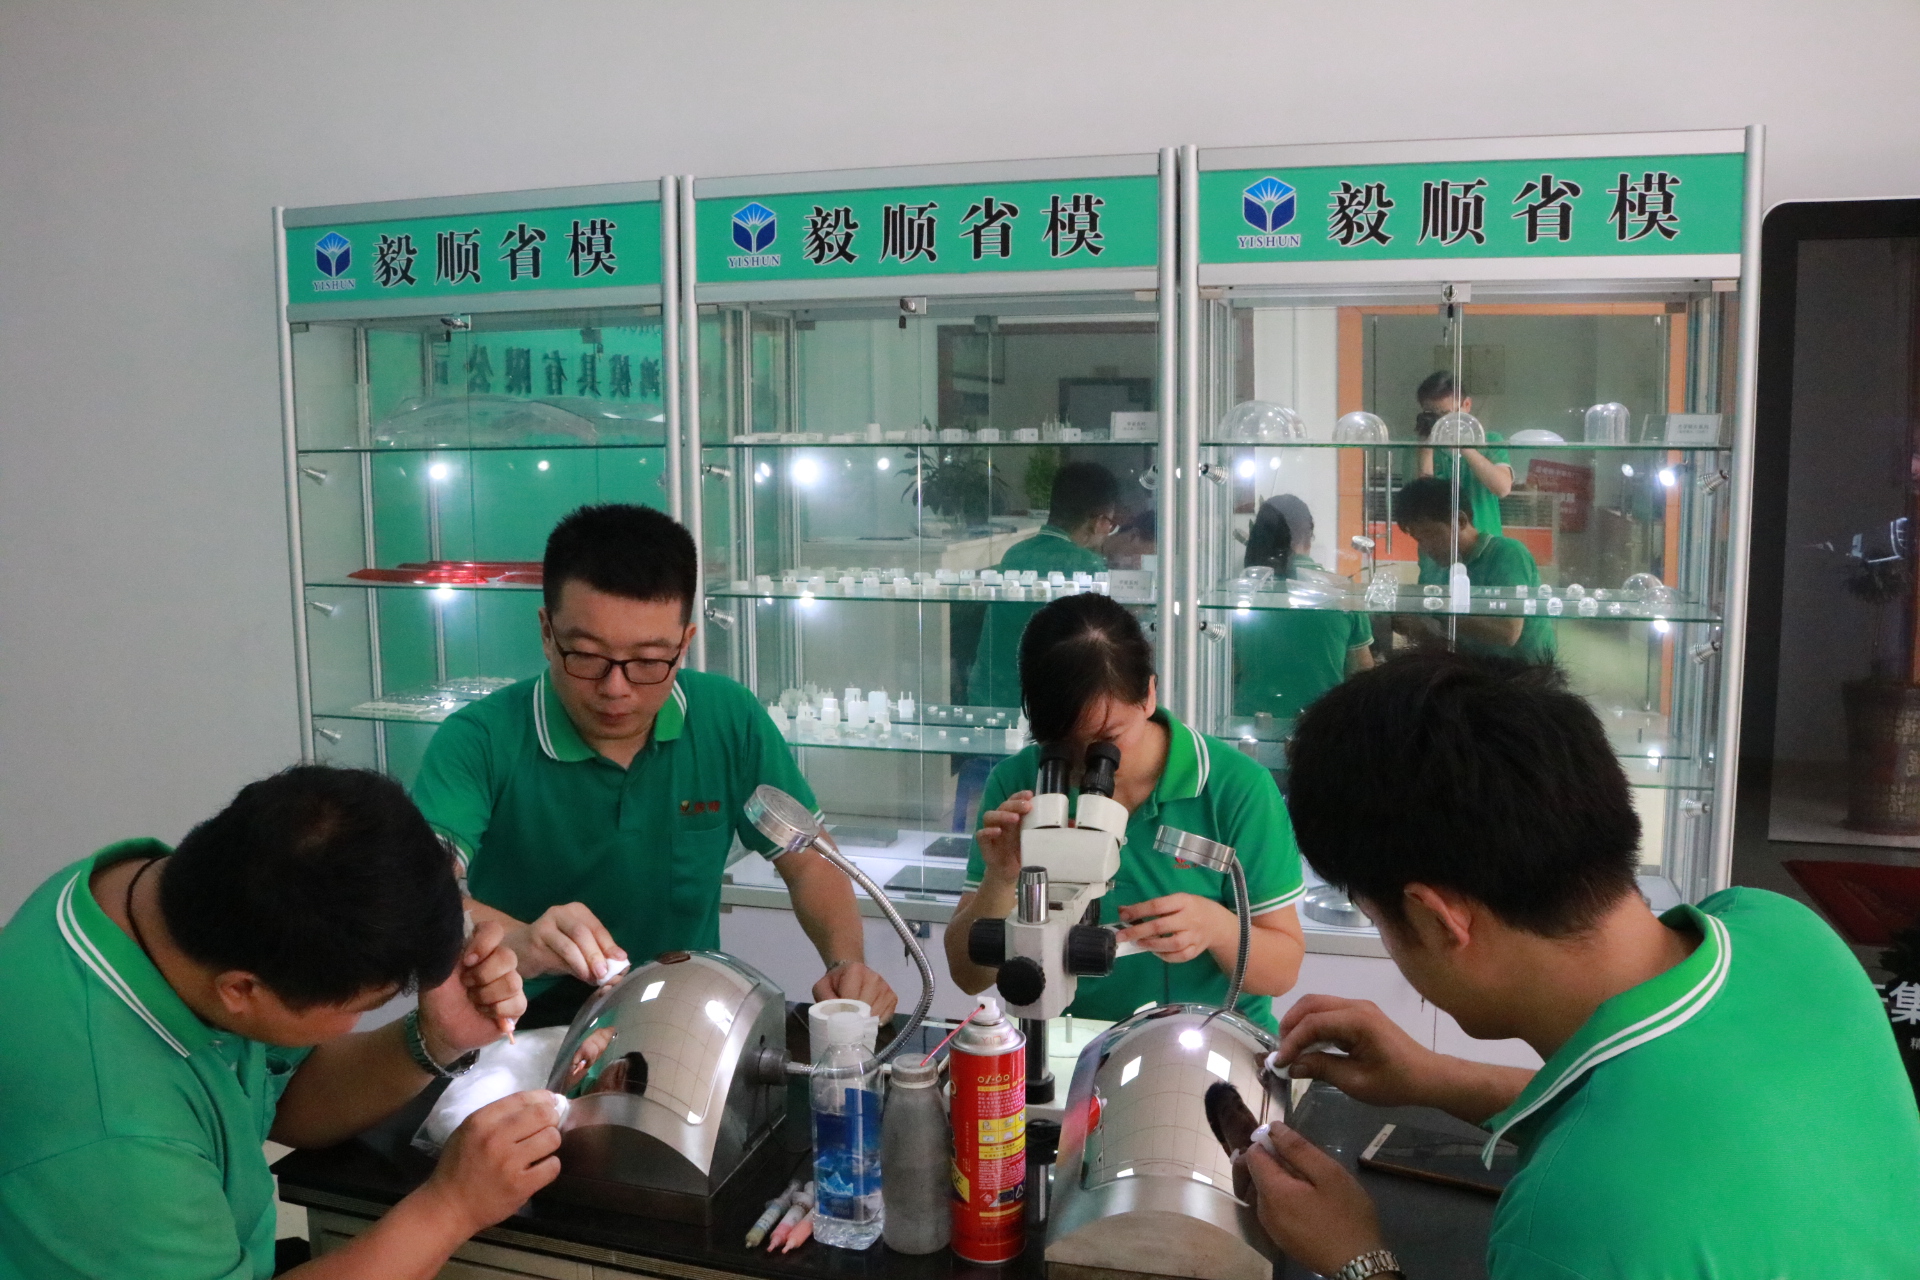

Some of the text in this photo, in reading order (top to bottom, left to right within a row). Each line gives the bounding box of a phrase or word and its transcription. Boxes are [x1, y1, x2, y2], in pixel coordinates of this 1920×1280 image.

[802, 193, 1105, 265] 毅顺省模
[1327, 172, 1681, 247] 毅顺省模
[373, 219, 618, 288] 毅顺省模
[728, 255, 780, 268] YISHUN
[1238, 235, 1300, 248] YISHUN
[313, 279, 355, 291] YISHUN
